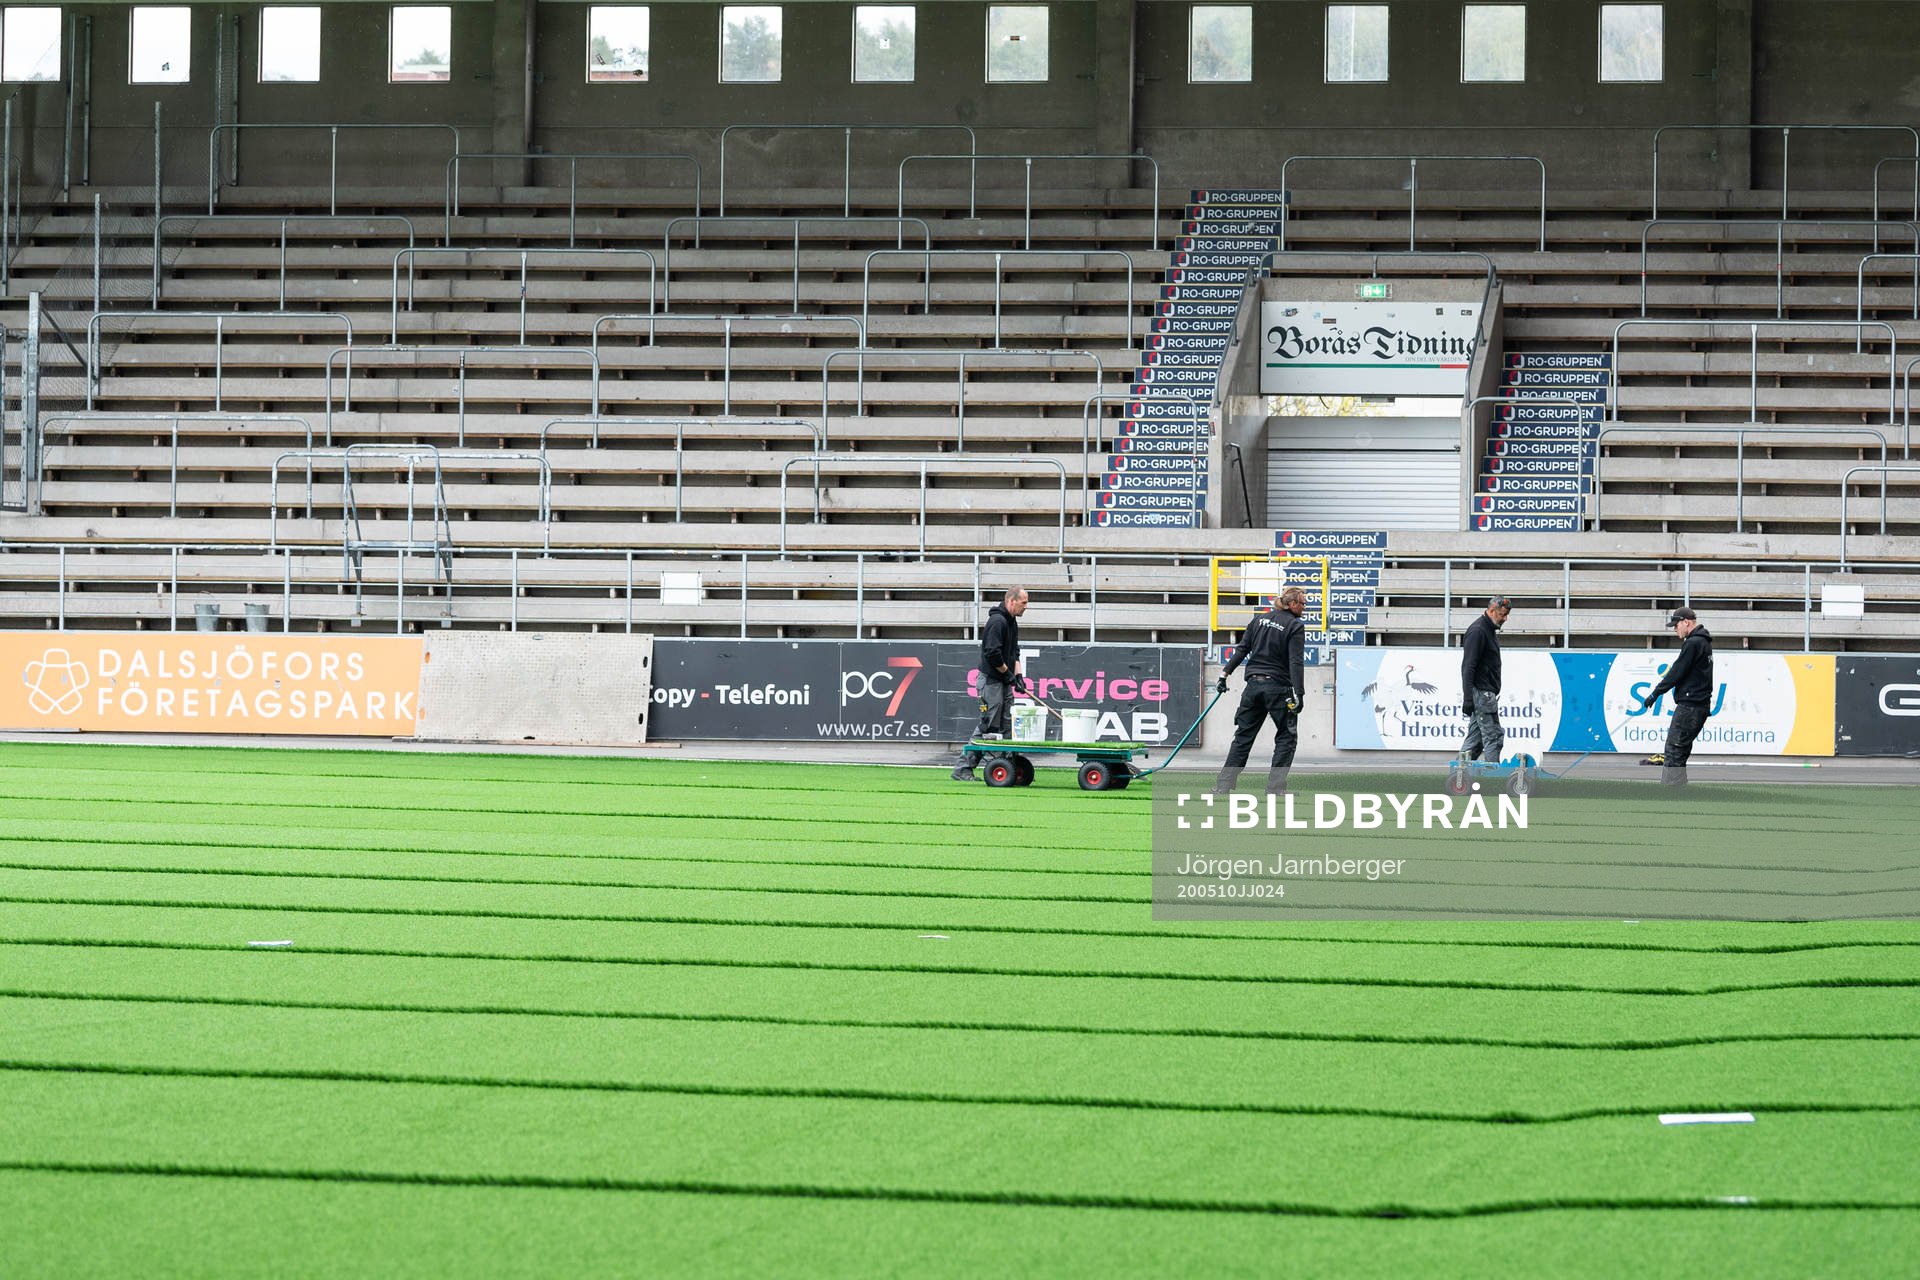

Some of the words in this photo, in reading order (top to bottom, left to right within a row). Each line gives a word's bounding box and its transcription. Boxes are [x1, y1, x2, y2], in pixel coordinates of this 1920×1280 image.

[1212, 193, 1282, 202] RO-GRUPPEN
[1207, 209, 1278, 218] RO-GRUPPEN
[1197, 241, 1268, 250] RO-GRUPPEN
[1188, 272, 1259, 281] RO-GRUPP
[1182, 289, 1243, 298] RO-GRUPP
[1177, 306, 1238, 314] RO-GRUPP
[1172, 322, 1233, 330] RO-GRUPP
[1168, 338, 1226, 348] RO-GRUPP
[1268, 326, 1361, 360] Borås
[1164, 355, 1222, 364] RO-GRUPP
[1528, 357, 1602, 366] RO-GRUPPEN
[1158, 372, 1217, 380] RO-GRUPP
[1524, 374, 1599, 383] RO-GRUPPEN
[1152, 388, 1214, 398] RO-GRUPP
[1148, 406, 1210, 416] RO-GRUPP
[1514, 426, 1590, 436] RO-GRUPPEN
[1511, 444, 1588, 454] RO-GRUPPEN
[1504, 480, 1579, 490] RO-GRUPPEN
[1498, 500, 1576, 510] RO-GRUPPEN
[1494, 519, 1572, 529] RO-GRUPPEN
[1299, 535, 1377, 545] RO-GRUPPEN
[98, 645, 364, 681] DALSJÖFORS
[842, 656, 924, 716] pc7
[650, 684, 696, 708] opy
[714, 684, 810, 706] Telefoni
[98, 682, 416, 721] FÖRETAGSPARK
[1400, 700, 1542, 720] Västerands
[817, 720, 931, 740] www.pc7.se
[1096, 712, 1168, 742] AB
[1402, 720, 1541, 739] Idrottsund
